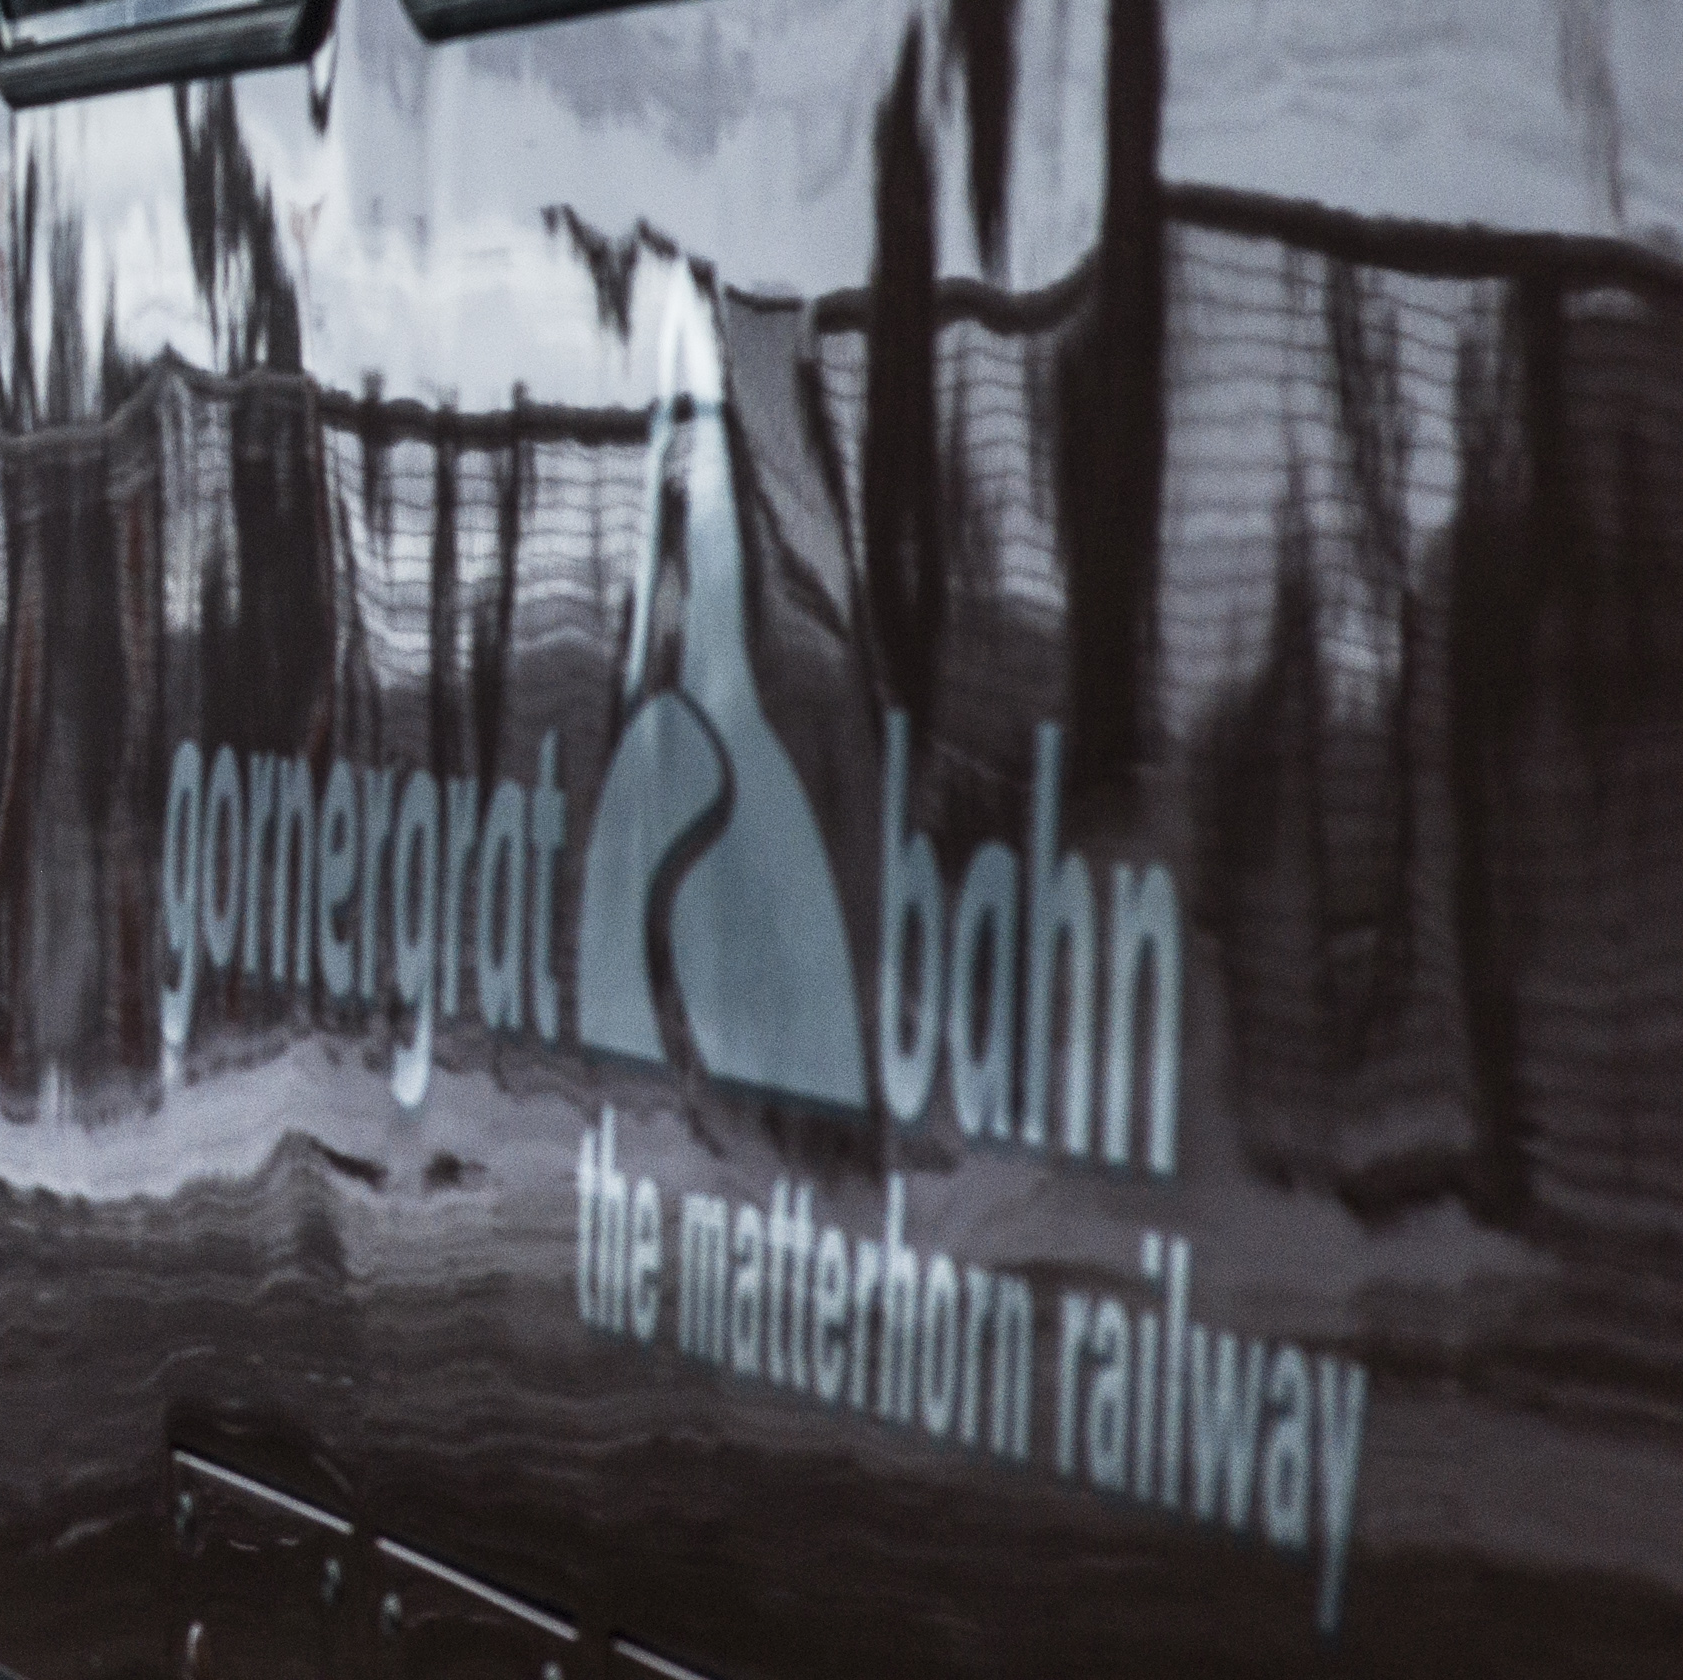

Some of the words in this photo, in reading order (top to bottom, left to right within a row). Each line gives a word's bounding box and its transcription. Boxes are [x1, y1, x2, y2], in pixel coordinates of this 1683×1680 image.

[162, 728, 567, 1108] gornergrat
[880, 707, 1180, 1175] bahn
[577, 1107, 662, 1340] the
[678, 1172, 1033, 1461] matterhorn
[1056, 1231, 1367, 1634] railway
